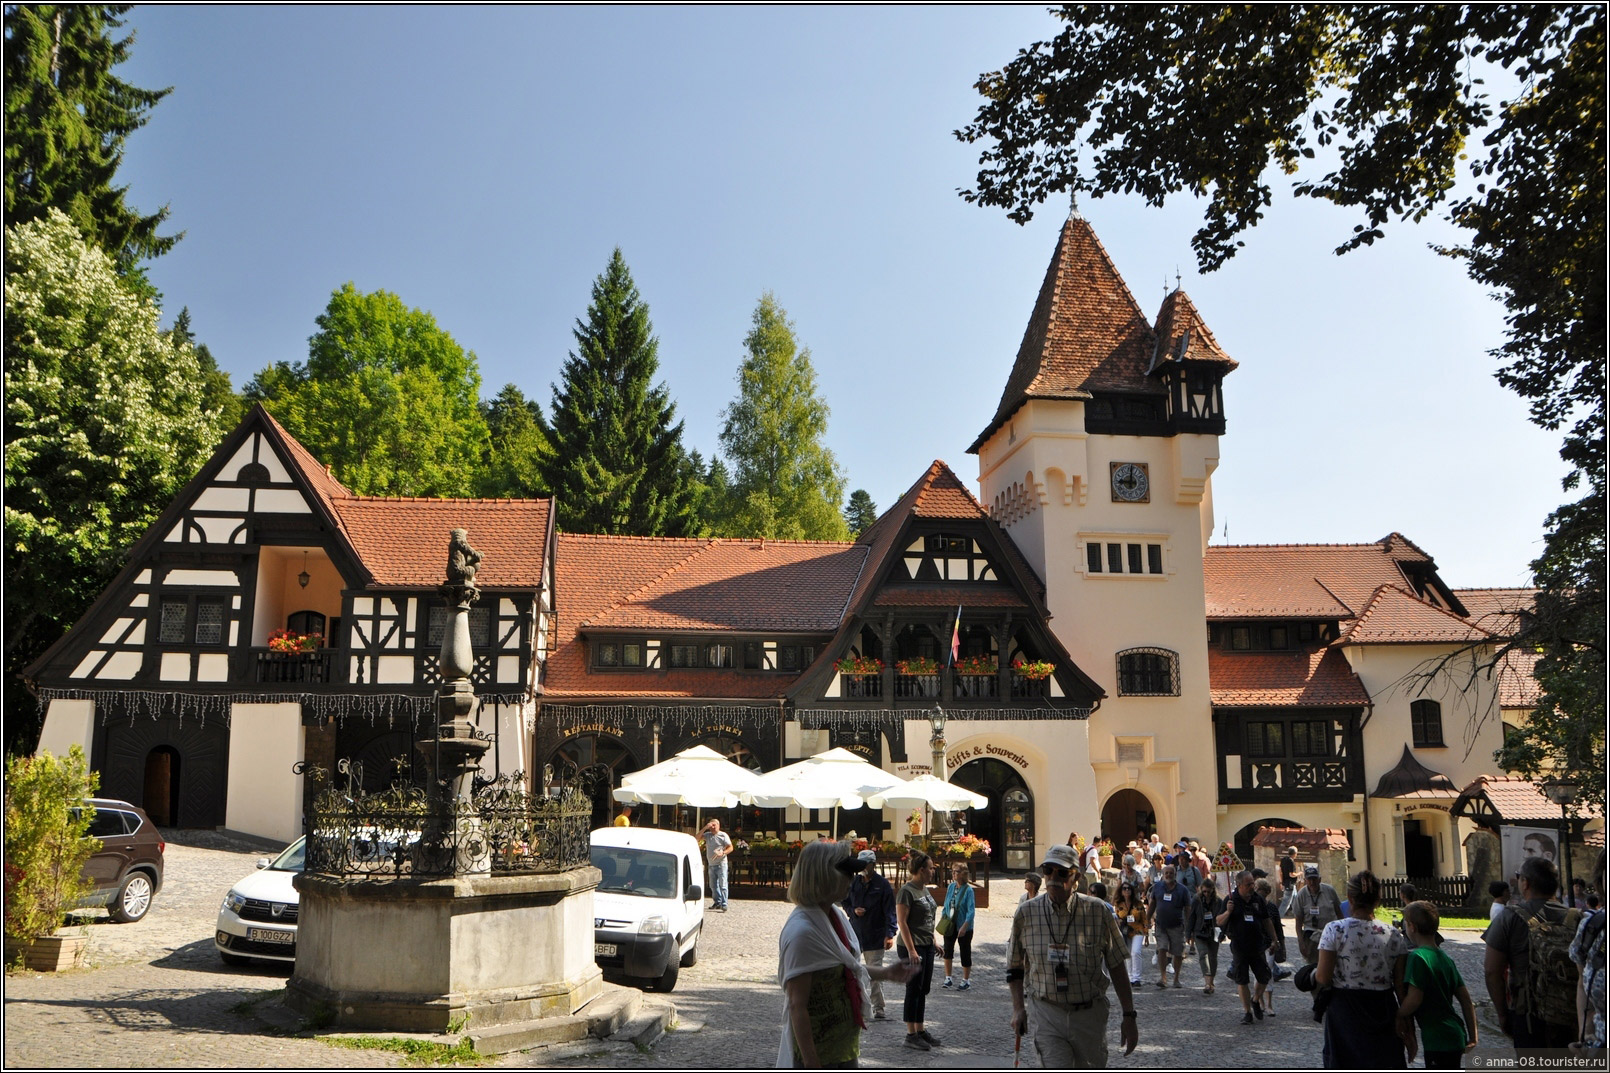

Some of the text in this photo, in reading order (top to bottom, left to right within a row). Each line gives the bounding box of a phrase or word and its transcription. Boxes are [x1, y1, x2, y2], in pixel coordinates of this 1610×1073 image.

[563, 723, 624, 737] RESTAURANT
[845, 744, 875, 756] CEPTIE
[946, 743, 1029, 769] Gifts & Souvenirs
